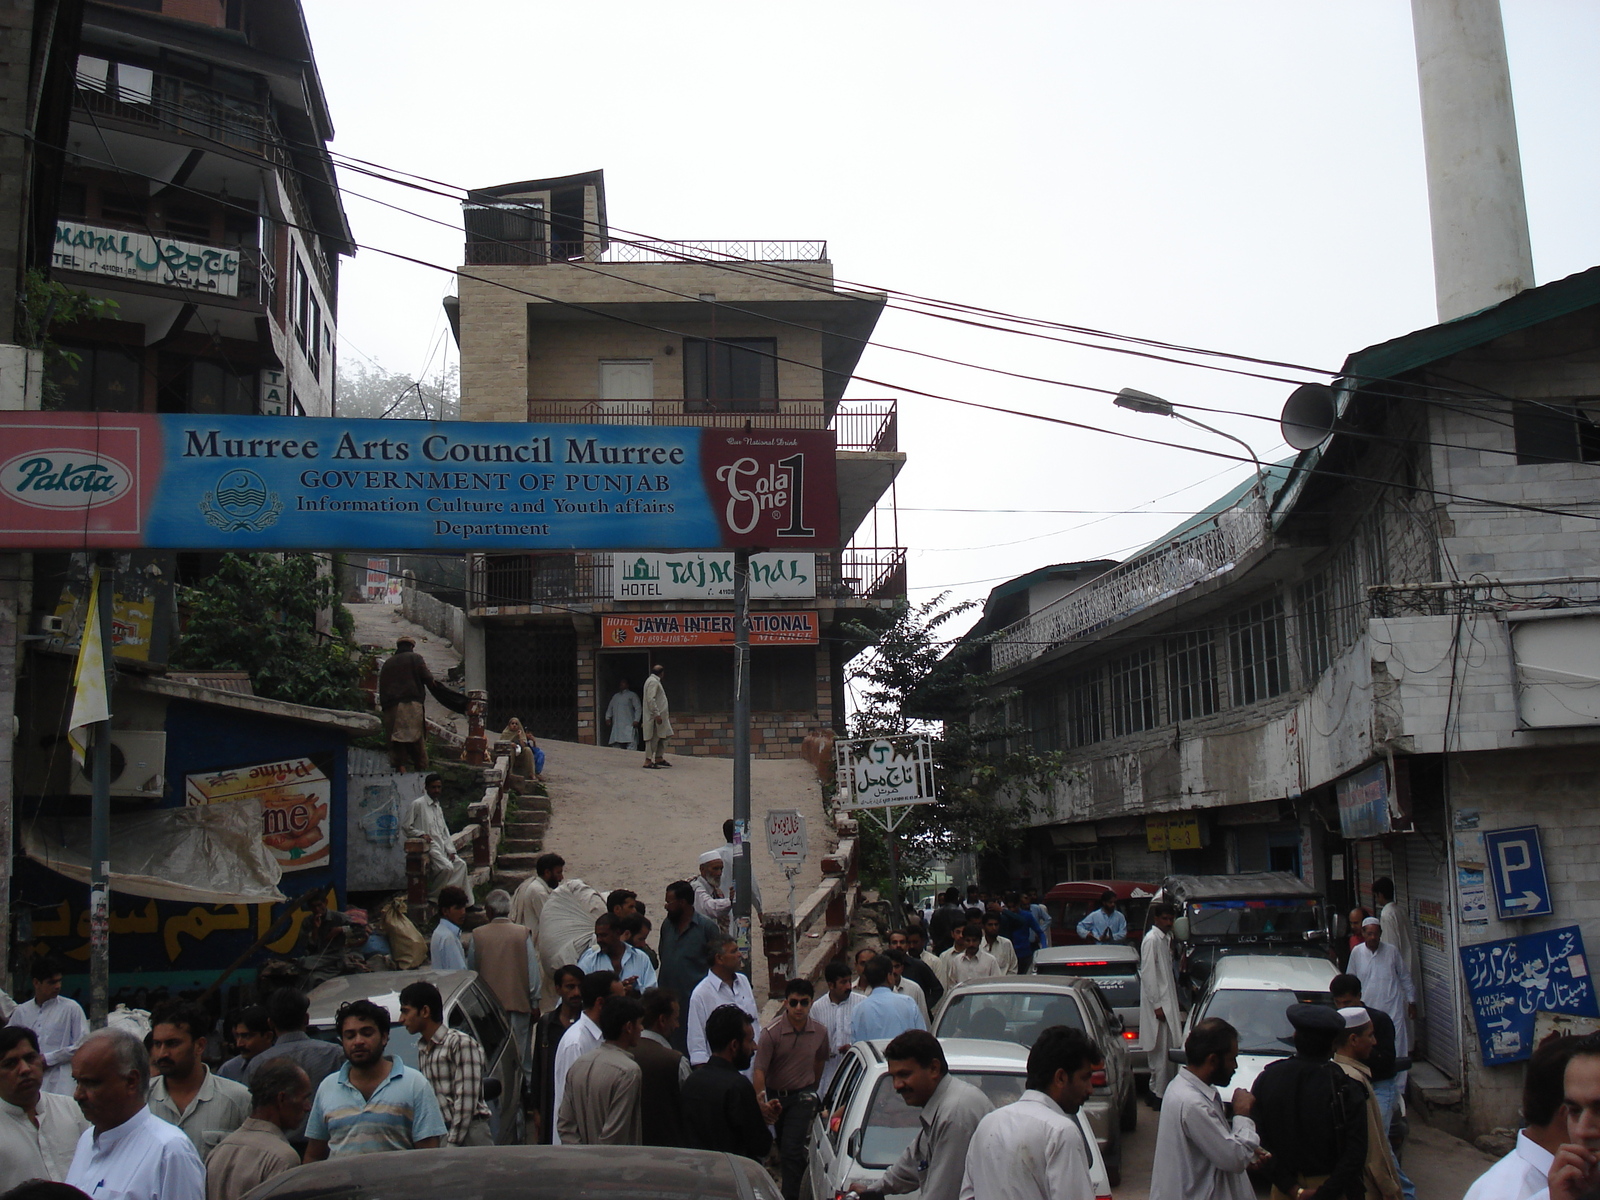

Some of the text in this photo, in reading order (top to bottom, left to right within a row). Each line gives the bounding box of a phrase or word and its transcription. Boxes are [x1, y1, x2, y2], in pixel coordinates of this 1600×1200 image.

[183, 430, 685, 465] Murree Arts Council Murree
[300, 470, 670, 495] GOVERNMENT OF PUNJAB
[777, 453, 815, 537] 1
[296, 496, 675, 513] Information Culture and Youth affairs
[434, 520, 549, 538] Department
[621, 583, 662, 596] HOTEL
[607, 618, 634, 626] HOTEL
[634, 616, 679, 632] JAWA
[633, 635, 647, 643] PH:
[757, 632, 813, 641] MURREE
[249, 761, 313, 778] Prime
[1497, 839, 1531, 895] P
